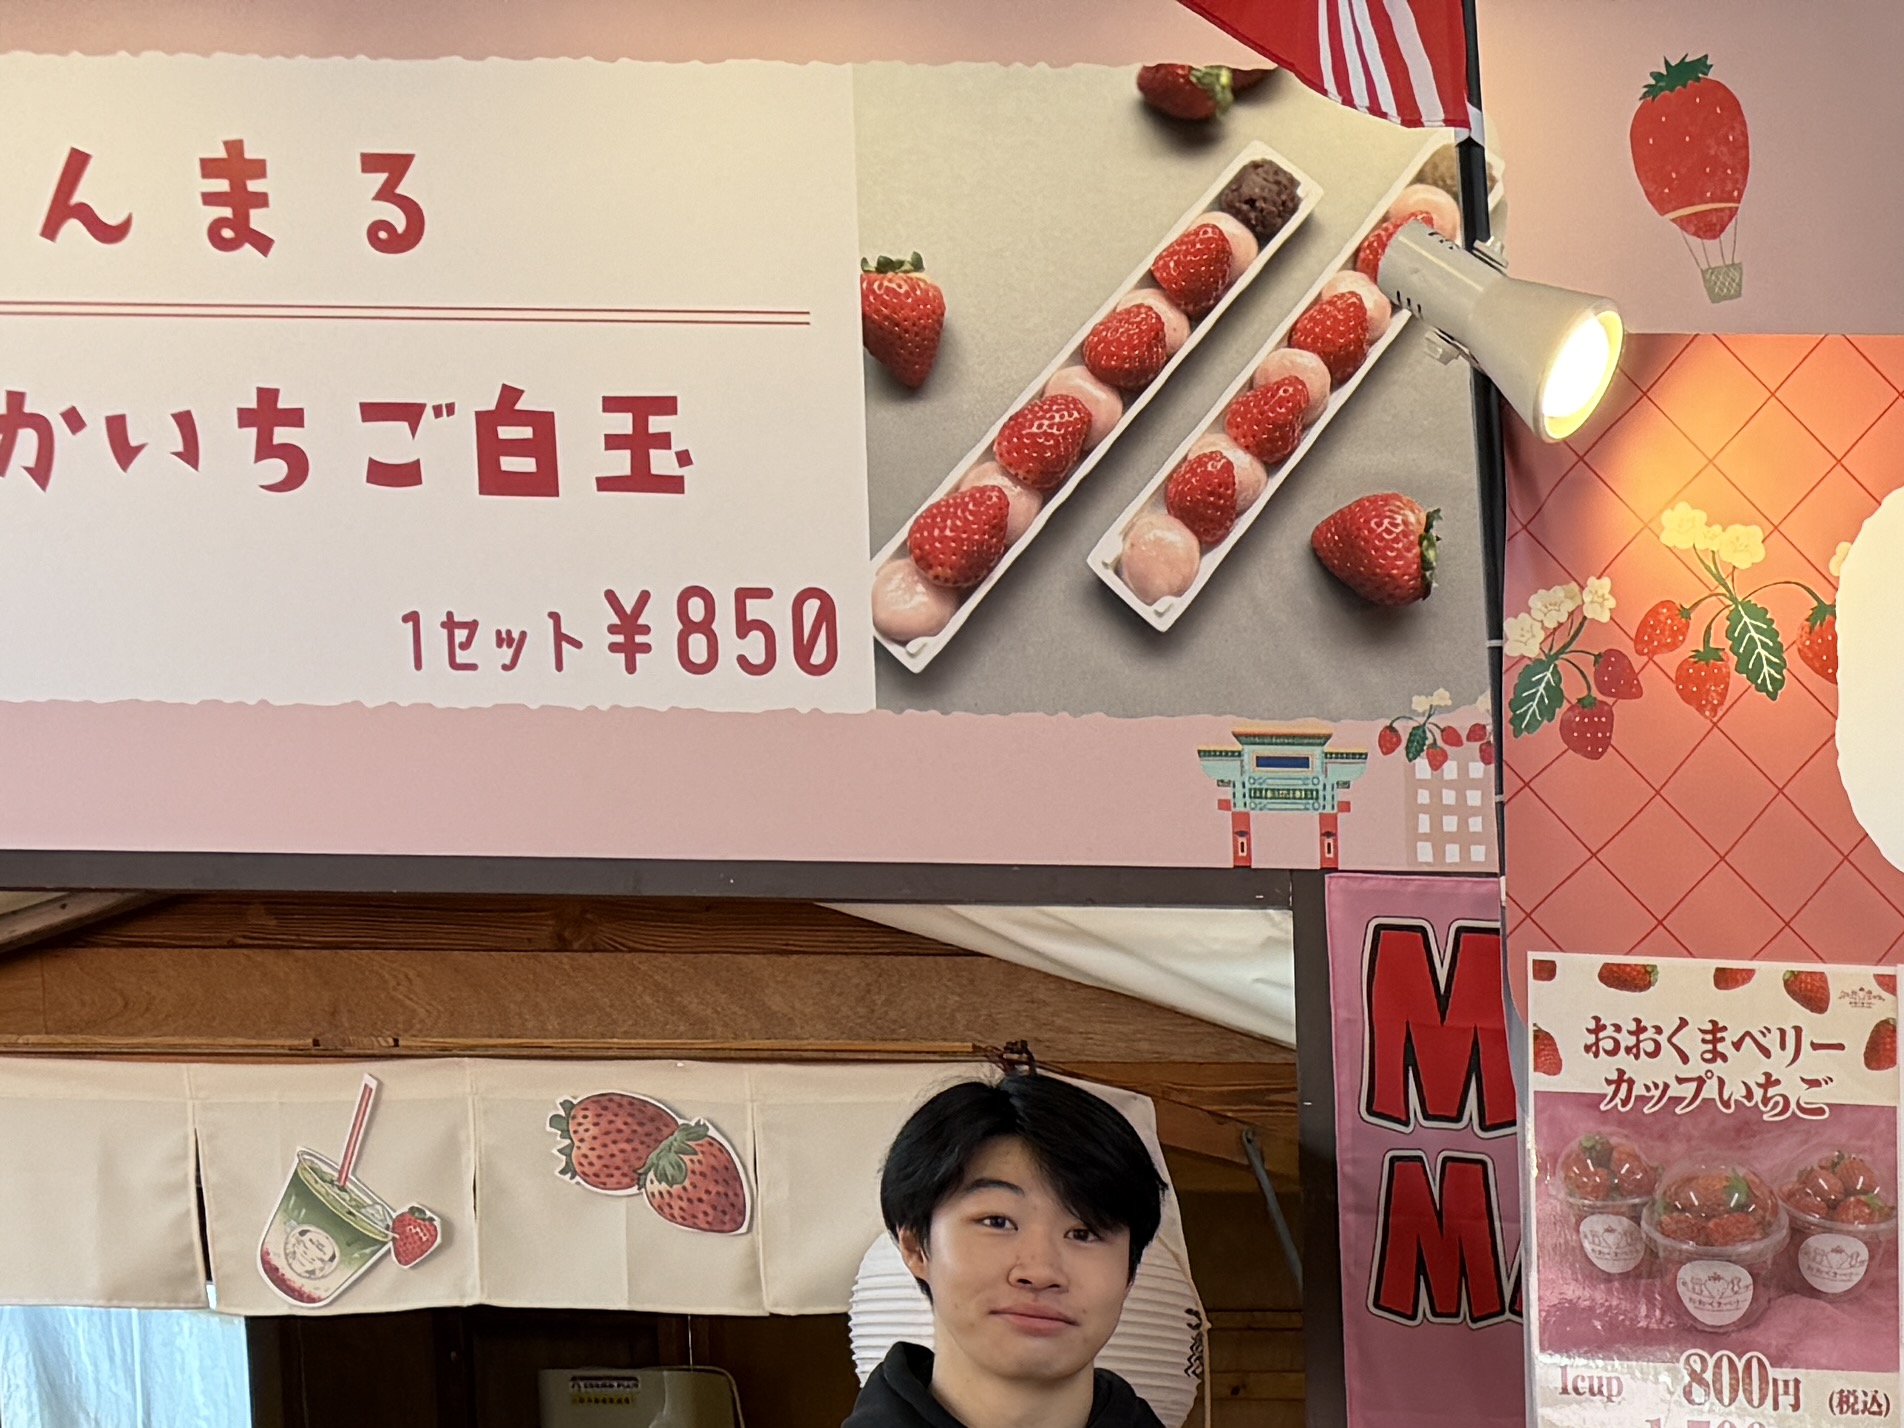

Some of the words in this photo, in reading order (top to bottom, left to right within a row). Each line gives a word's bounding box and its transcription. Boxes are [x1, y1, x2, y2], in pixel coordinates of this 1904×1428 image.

[38, 138, 428, 259] んまる
[0, 382, 693, 498] かいちご白玉
[401, 608, 586, 677] 1セット
[606, 587, 840, 678] ¥850
[1583, 1016, 1845, 1068] おおくまベリー
[1600, 1068, 1835, 1121] カップいちご
[1557, 1366, 1624, 1401] 1cup
[1680, 1349, 1802, 1414] 800円
[1828, 1389, 1891, 1417] (税込)
